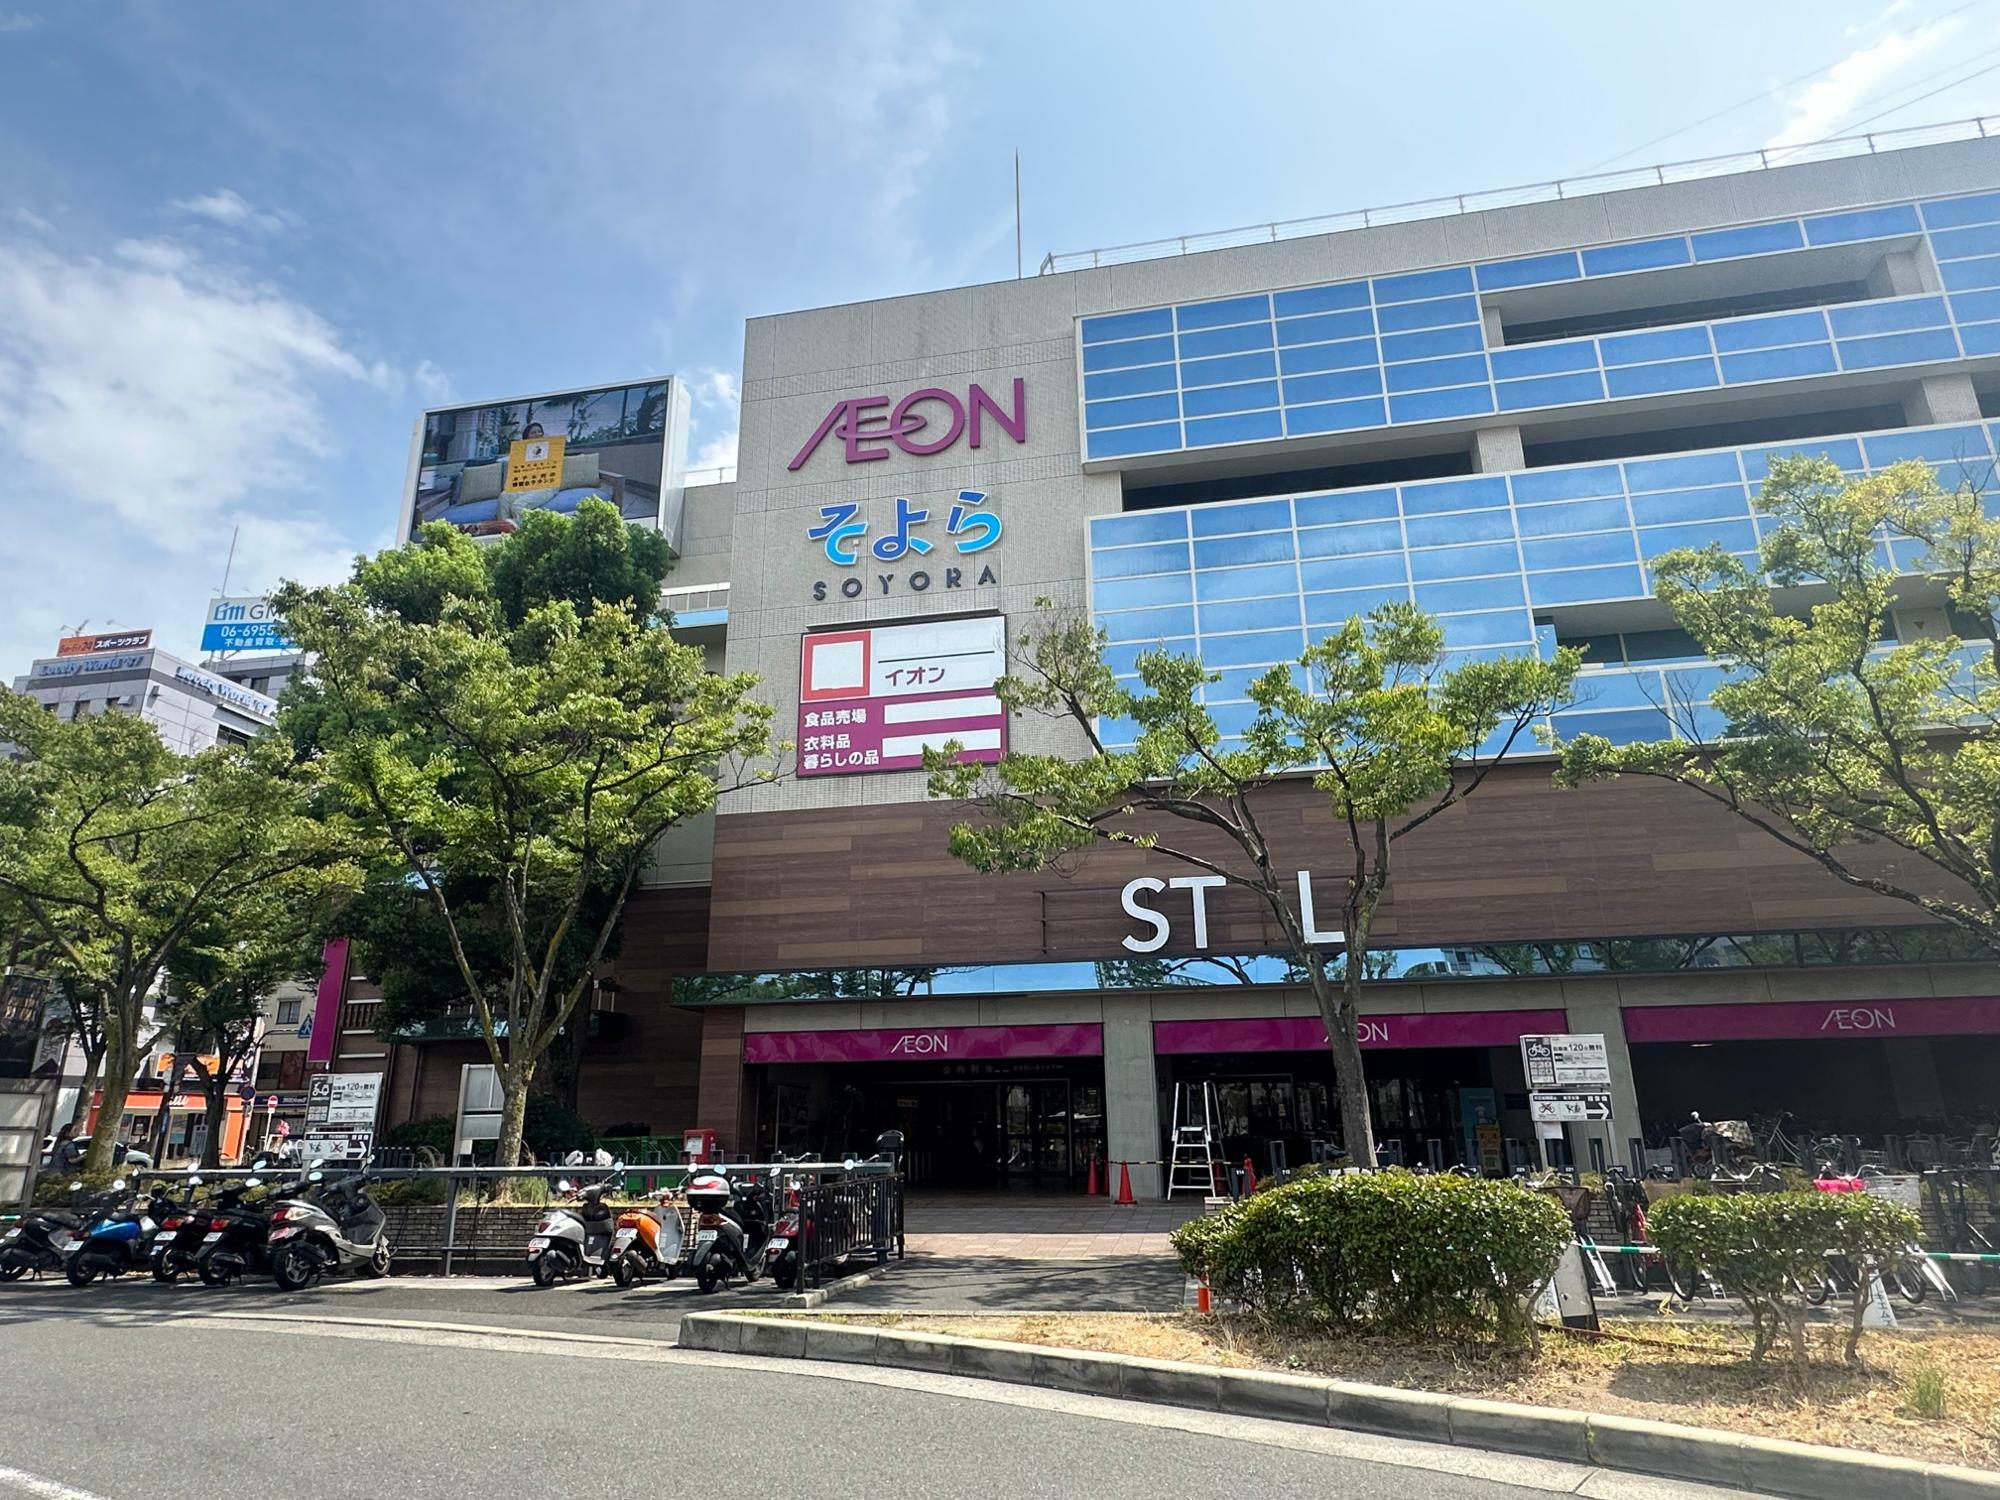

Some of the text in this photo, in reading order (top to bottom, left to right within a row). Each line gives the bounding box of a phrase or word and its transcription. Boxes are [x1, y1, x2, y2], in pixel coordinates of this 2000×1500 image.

[807, 490, 1002, 566] そよら
[813, 565, 997, 601] SOYORA
[94, 635, 148, 650] スポーツクラブ
[82, 657, 120, 671] World
[885, 666, 945, 687] イオン
[803, 708, 867, 728] 食品売場
[803, 733, 850, 751] 衣料品
[803, 749, 880, 770] 暮らしの品
